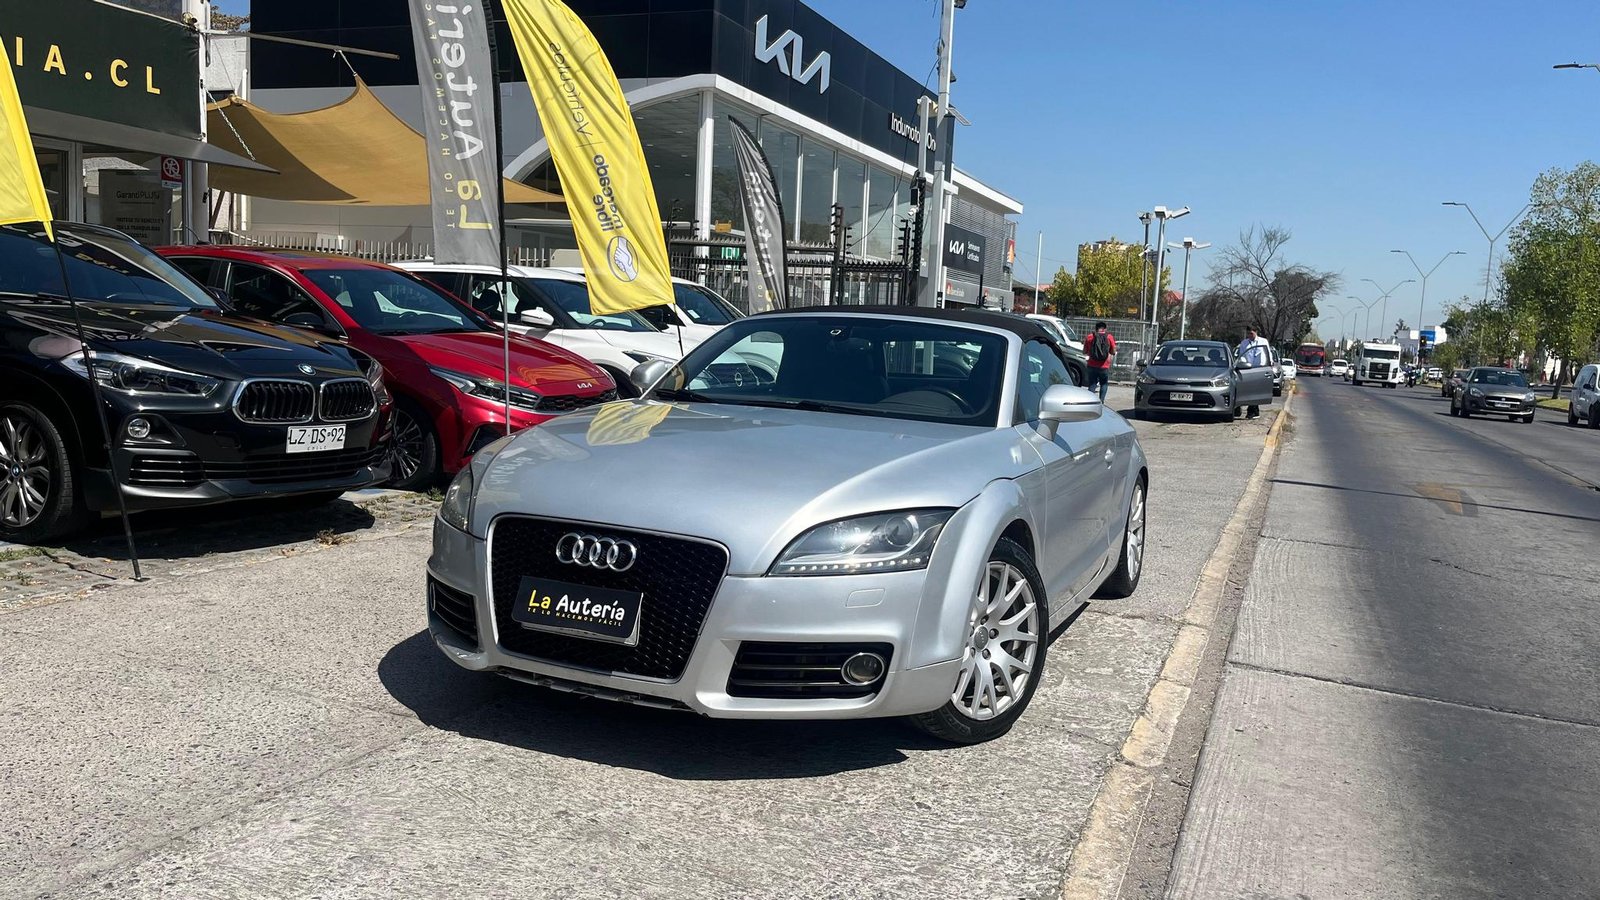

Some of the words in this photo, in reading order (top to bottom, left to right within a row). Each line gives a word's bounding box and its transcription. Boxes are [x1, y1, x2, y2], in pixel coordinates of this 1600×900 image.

[755, 14, 831, 94] KIA
[891, 112, 920, 144] Indumoto
[949, 240, 964, 255] KIA
[528, 589, 551, 609] La
[555, 594, 625, 621] Autería
[555, 612, 593, 622] HACEMOS
